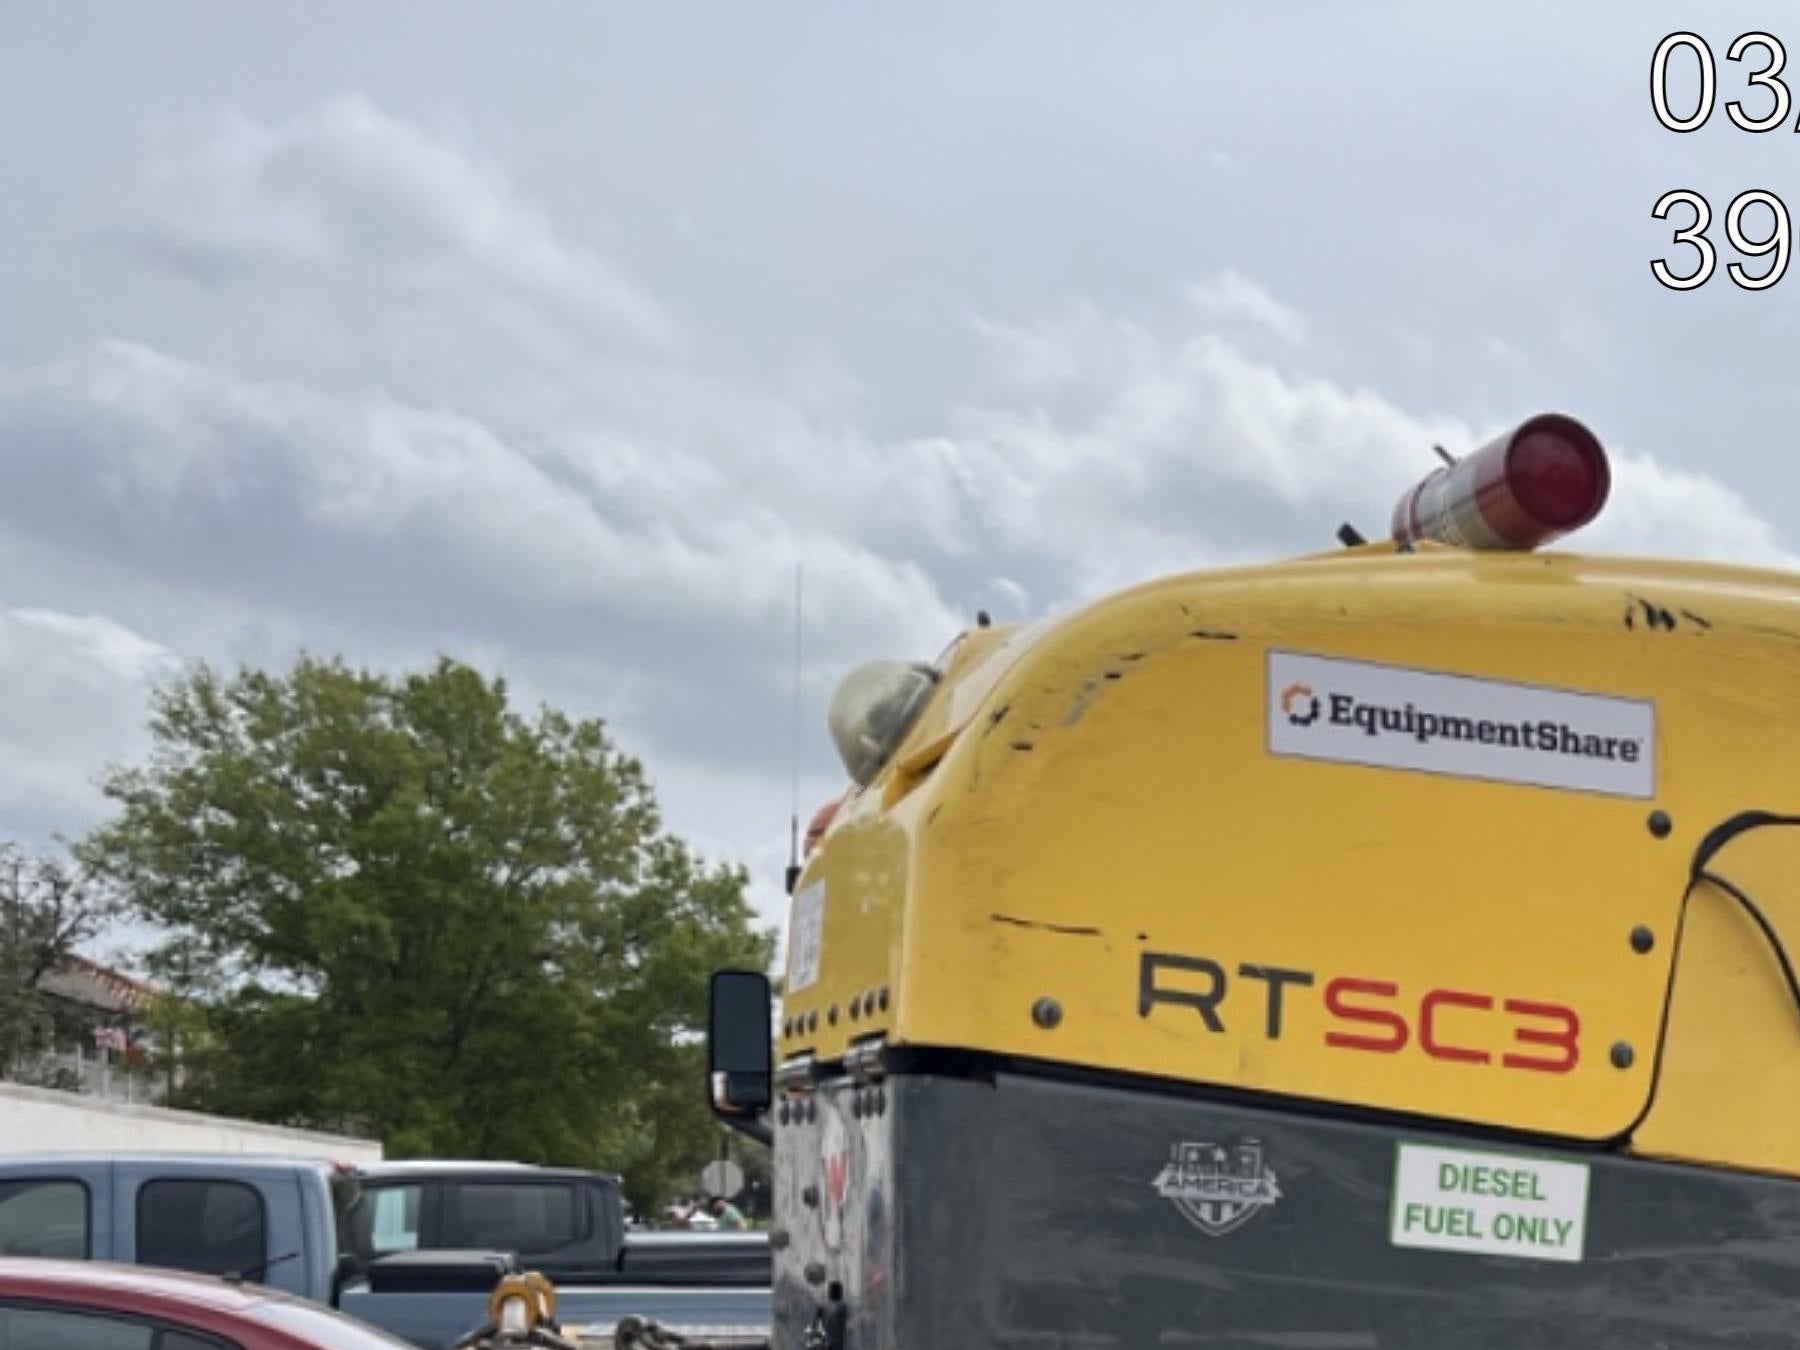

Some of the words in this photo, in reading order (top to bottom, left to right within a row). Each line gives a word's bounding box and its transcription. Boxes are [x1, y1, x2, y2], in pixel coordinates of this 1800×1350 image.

[1328, 693, 1640, 763] EquipmentShare
[1438, 1162, 1547, 1201] DIESEL
[1404, 1203, 1482, 1239] FUEL
[1492, 1211, 1573, 1247] ONLY
